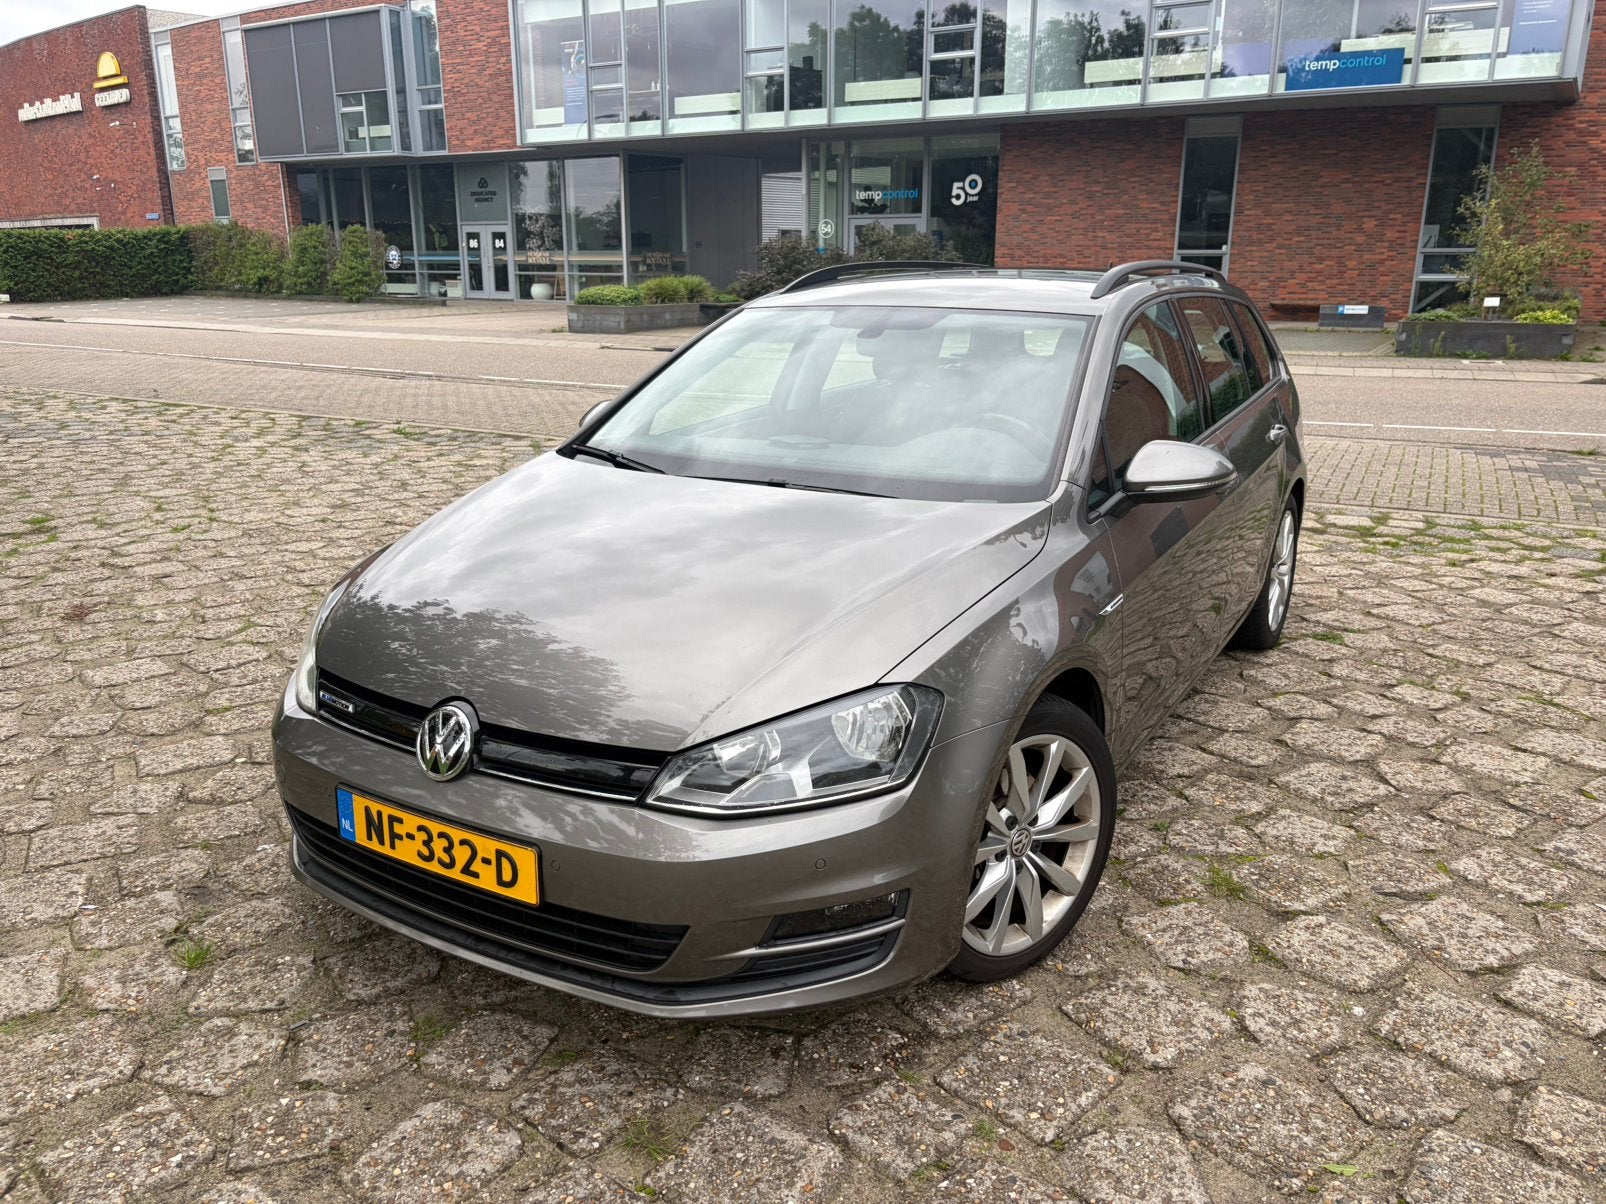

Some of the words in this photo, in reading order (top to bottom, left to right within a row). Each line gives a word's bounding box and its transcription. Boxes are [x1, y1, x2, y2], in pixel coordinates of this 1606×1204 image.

[1305, 54, 1387, 72] tempcontrol
[856, 188, 919, 202] tempcontrol
[950, 173, 983, 206] 50
[966, 194, 980, 203] jaar
[820, 223, 832, 234] 54
[469, 238, 479, 249] 86
[494, 238, 505, 249] 84
[341, 817, 354, 832] NL
[364, 805, 519, 889] NF-332-D
